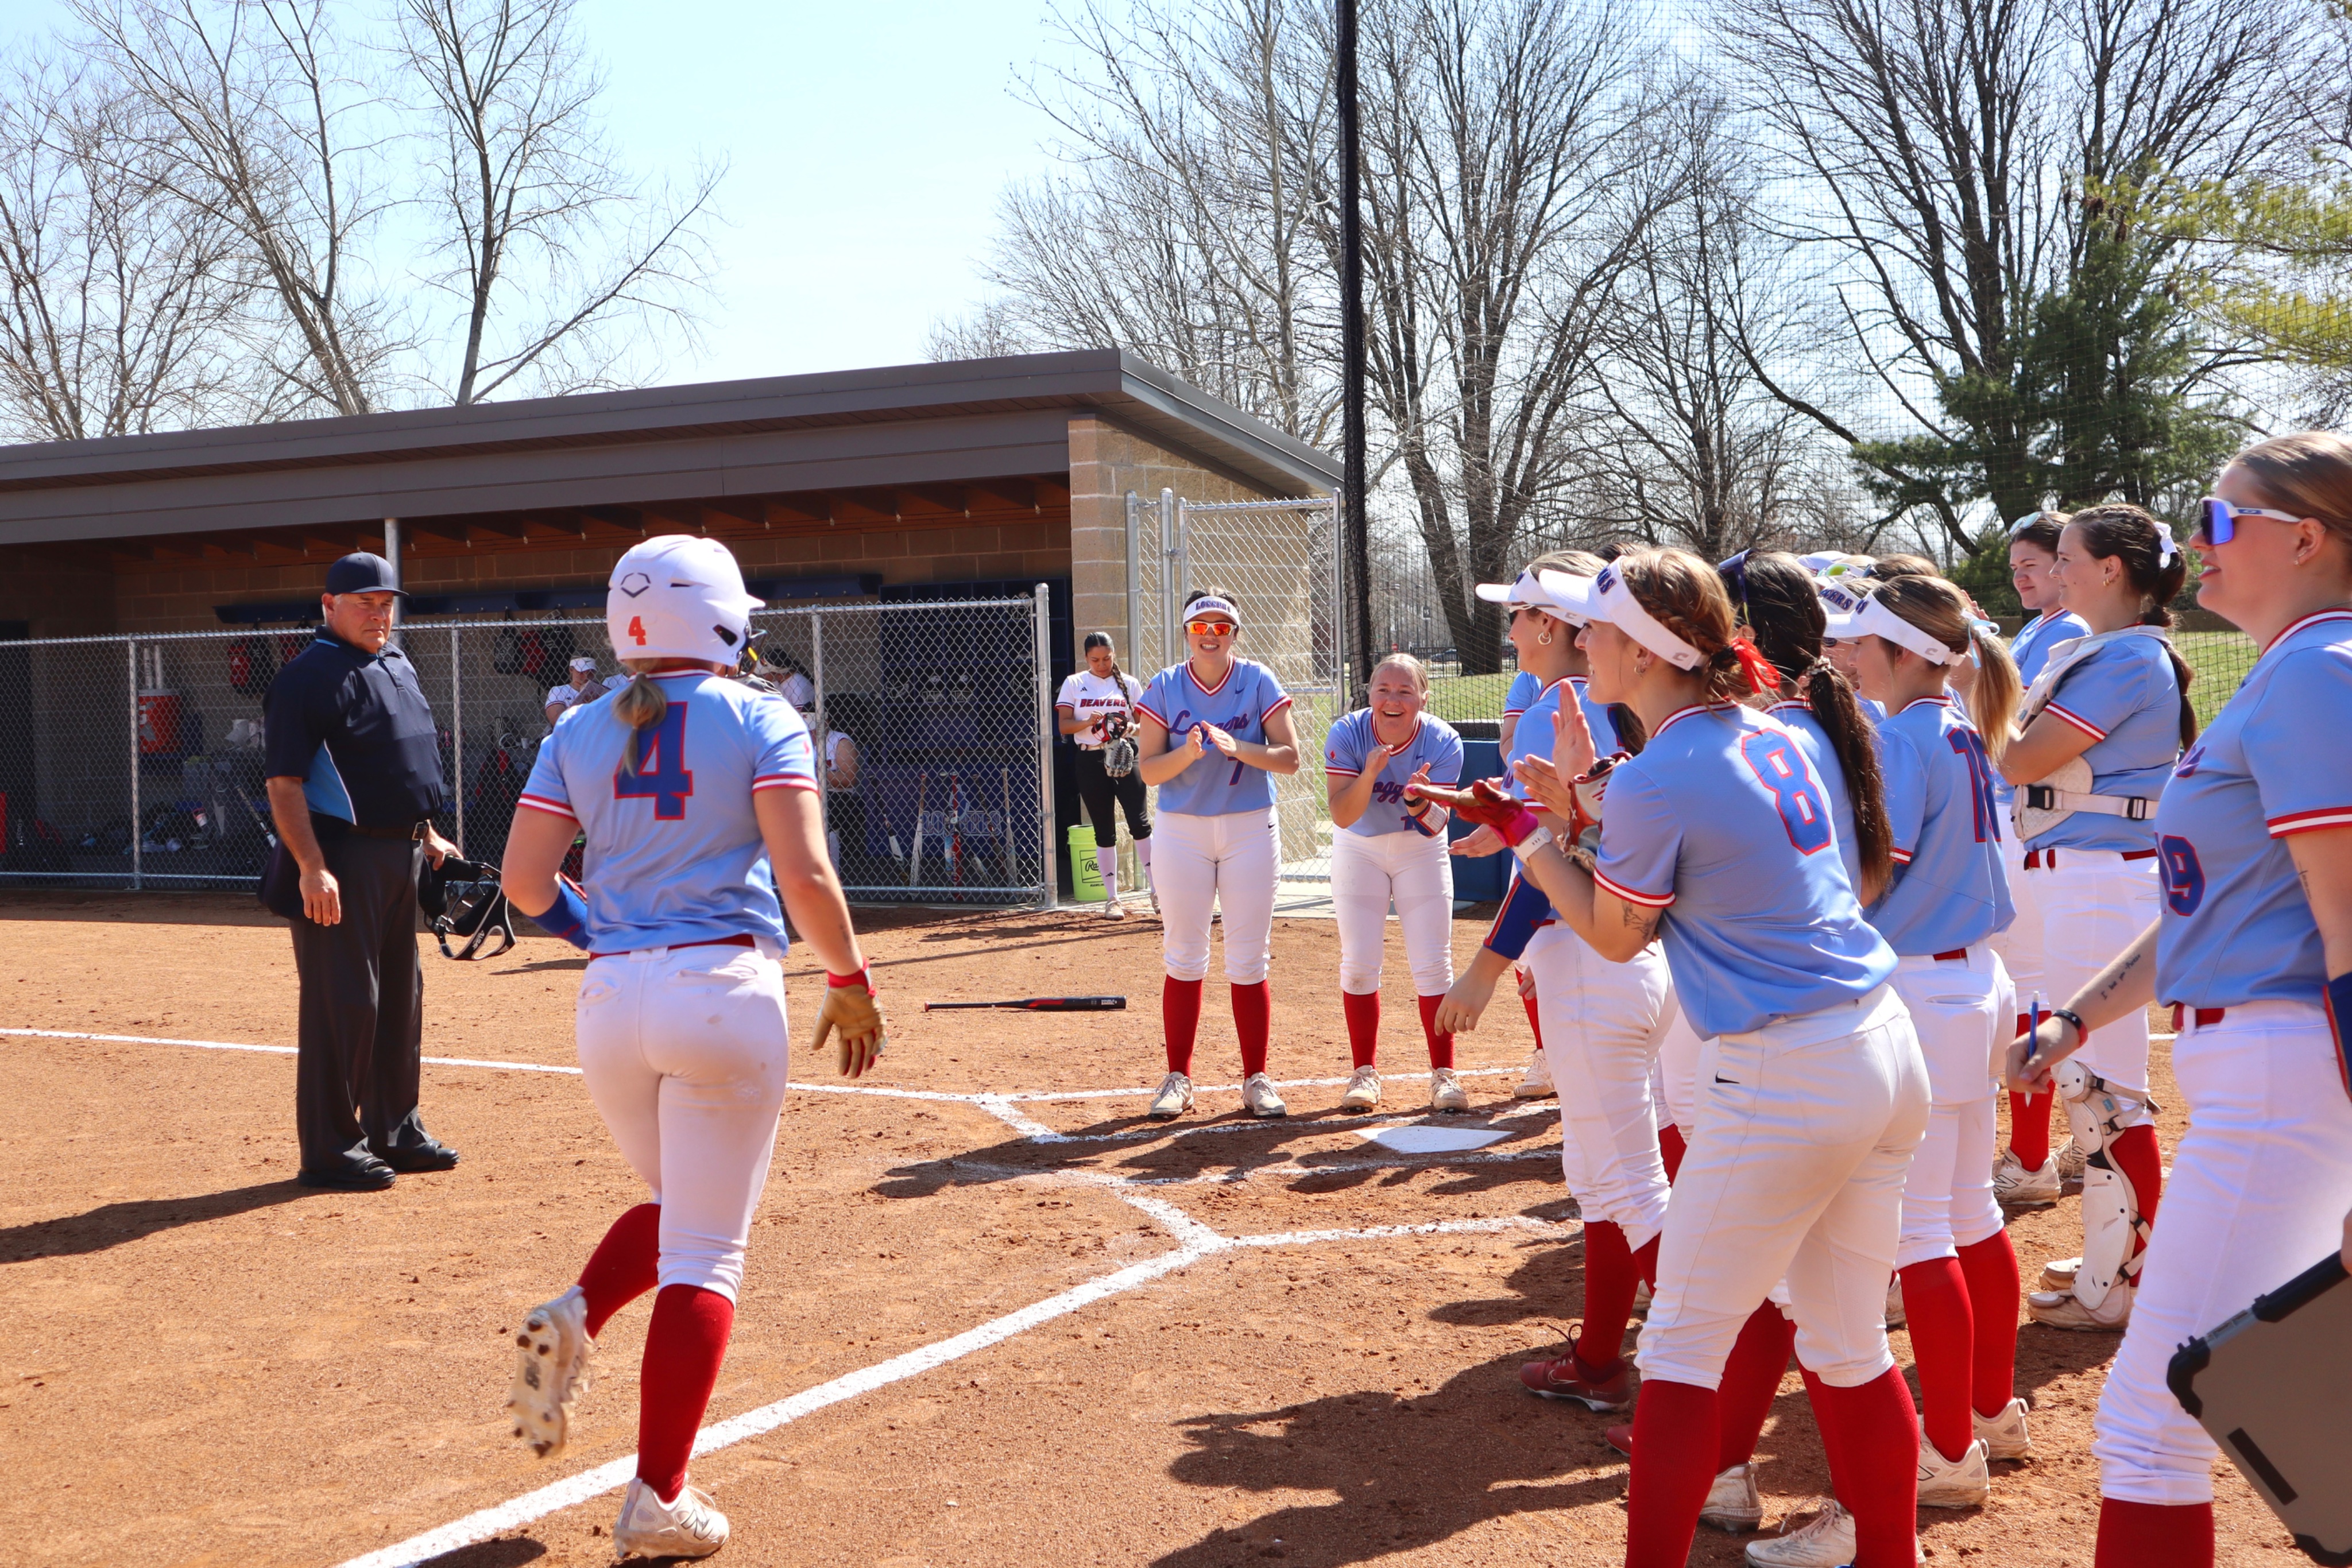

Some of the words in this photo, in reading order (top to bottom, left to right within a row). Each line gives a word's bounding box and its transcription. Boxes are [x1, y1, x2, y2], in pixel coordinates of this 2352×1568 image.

[628, 615, 646, 645] 4
[1080, 699, 1125, 707] BEAVERS
[613, 702, 693, 820] 4
[1228, 756, 1244, 785] 7
[1741, 727, 1832, 856] 8
